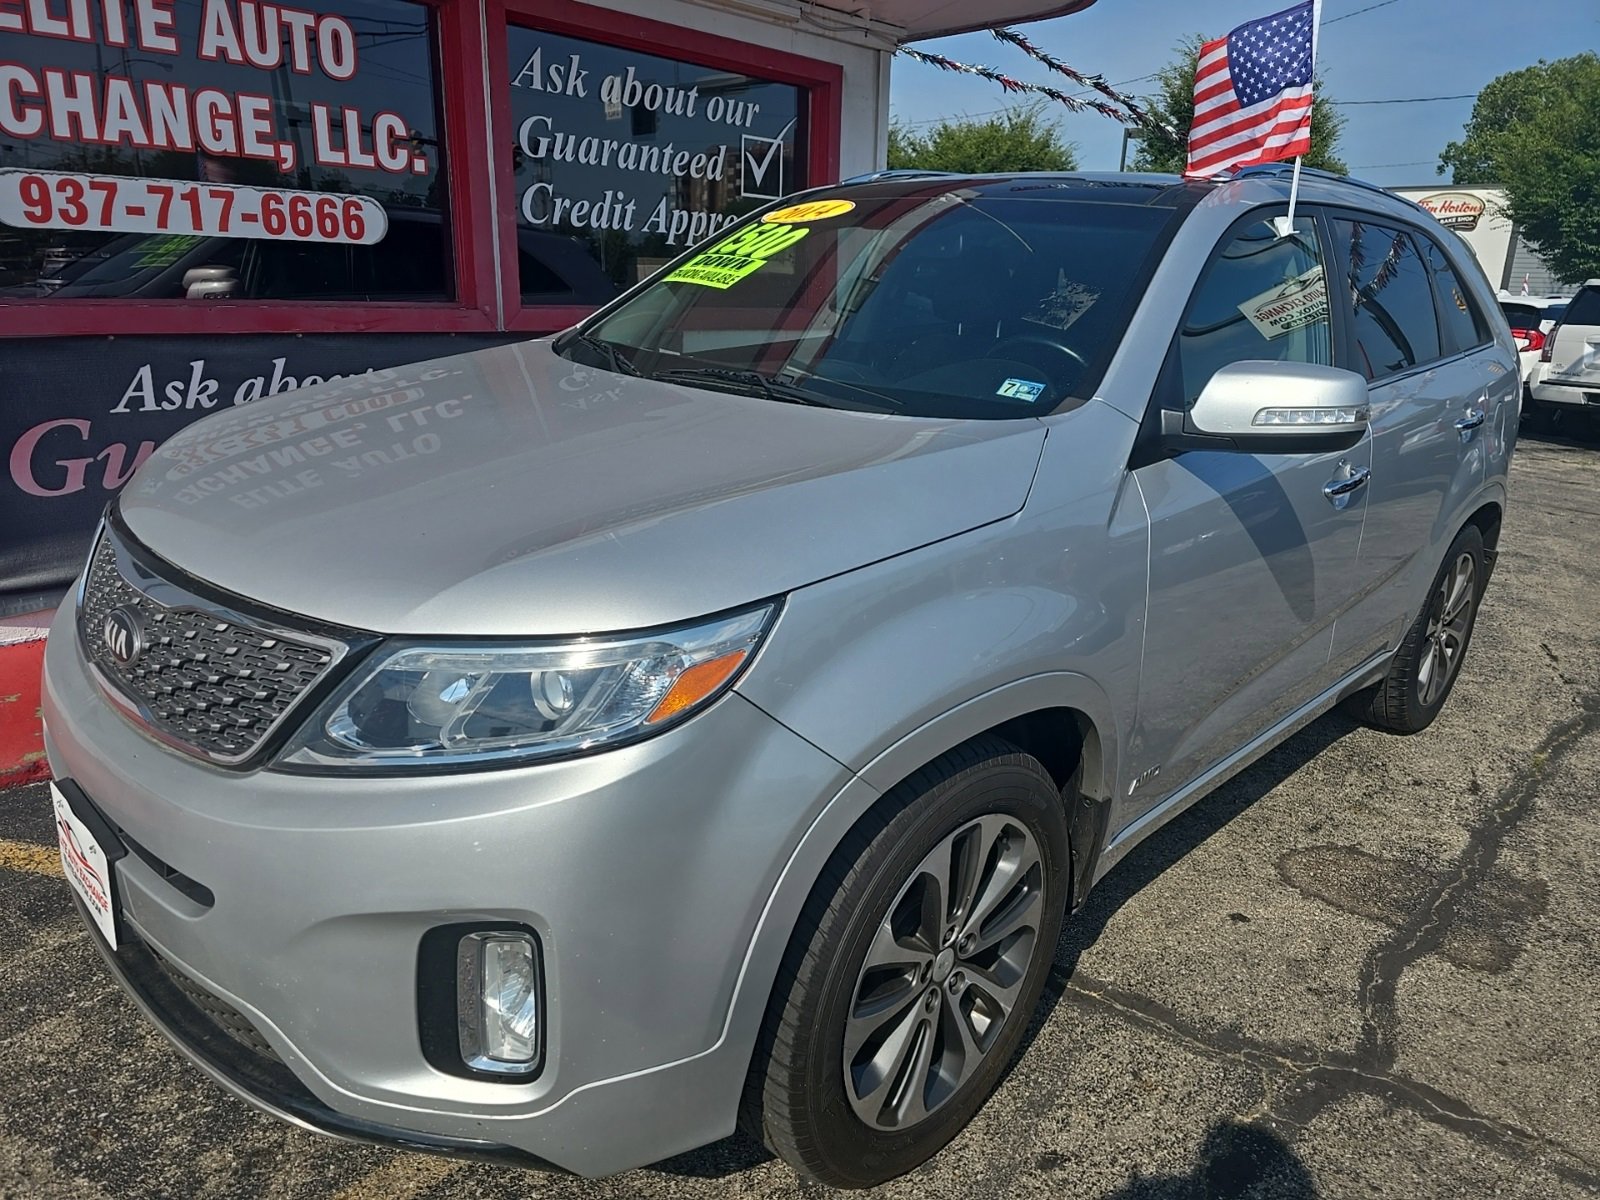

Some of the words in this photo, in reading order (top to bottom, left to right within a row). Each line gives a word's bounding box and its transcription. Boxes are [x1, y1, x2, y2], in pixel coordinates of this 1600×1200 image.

[199, 0, 357, 80] AUTO
[511, 47, 590, 98] Ask
[600, 67, 699, 118] about
[706, 96, 760, 128] our
[311, 102, 427, 174] LLC.
[519, 115, 728, 181] Guaranteed
[18, 176, 366, 241] 937-717-6666
[521, 182, 637, 232] Credit
[1457, 215, 1474, 223] SHOP
[690, 255, 756, 273] DOWN
[109, 359, 219, 415] Ask
[1003, 382, 1018, 394] 7
[1027, 386, 1042, 396] 23
